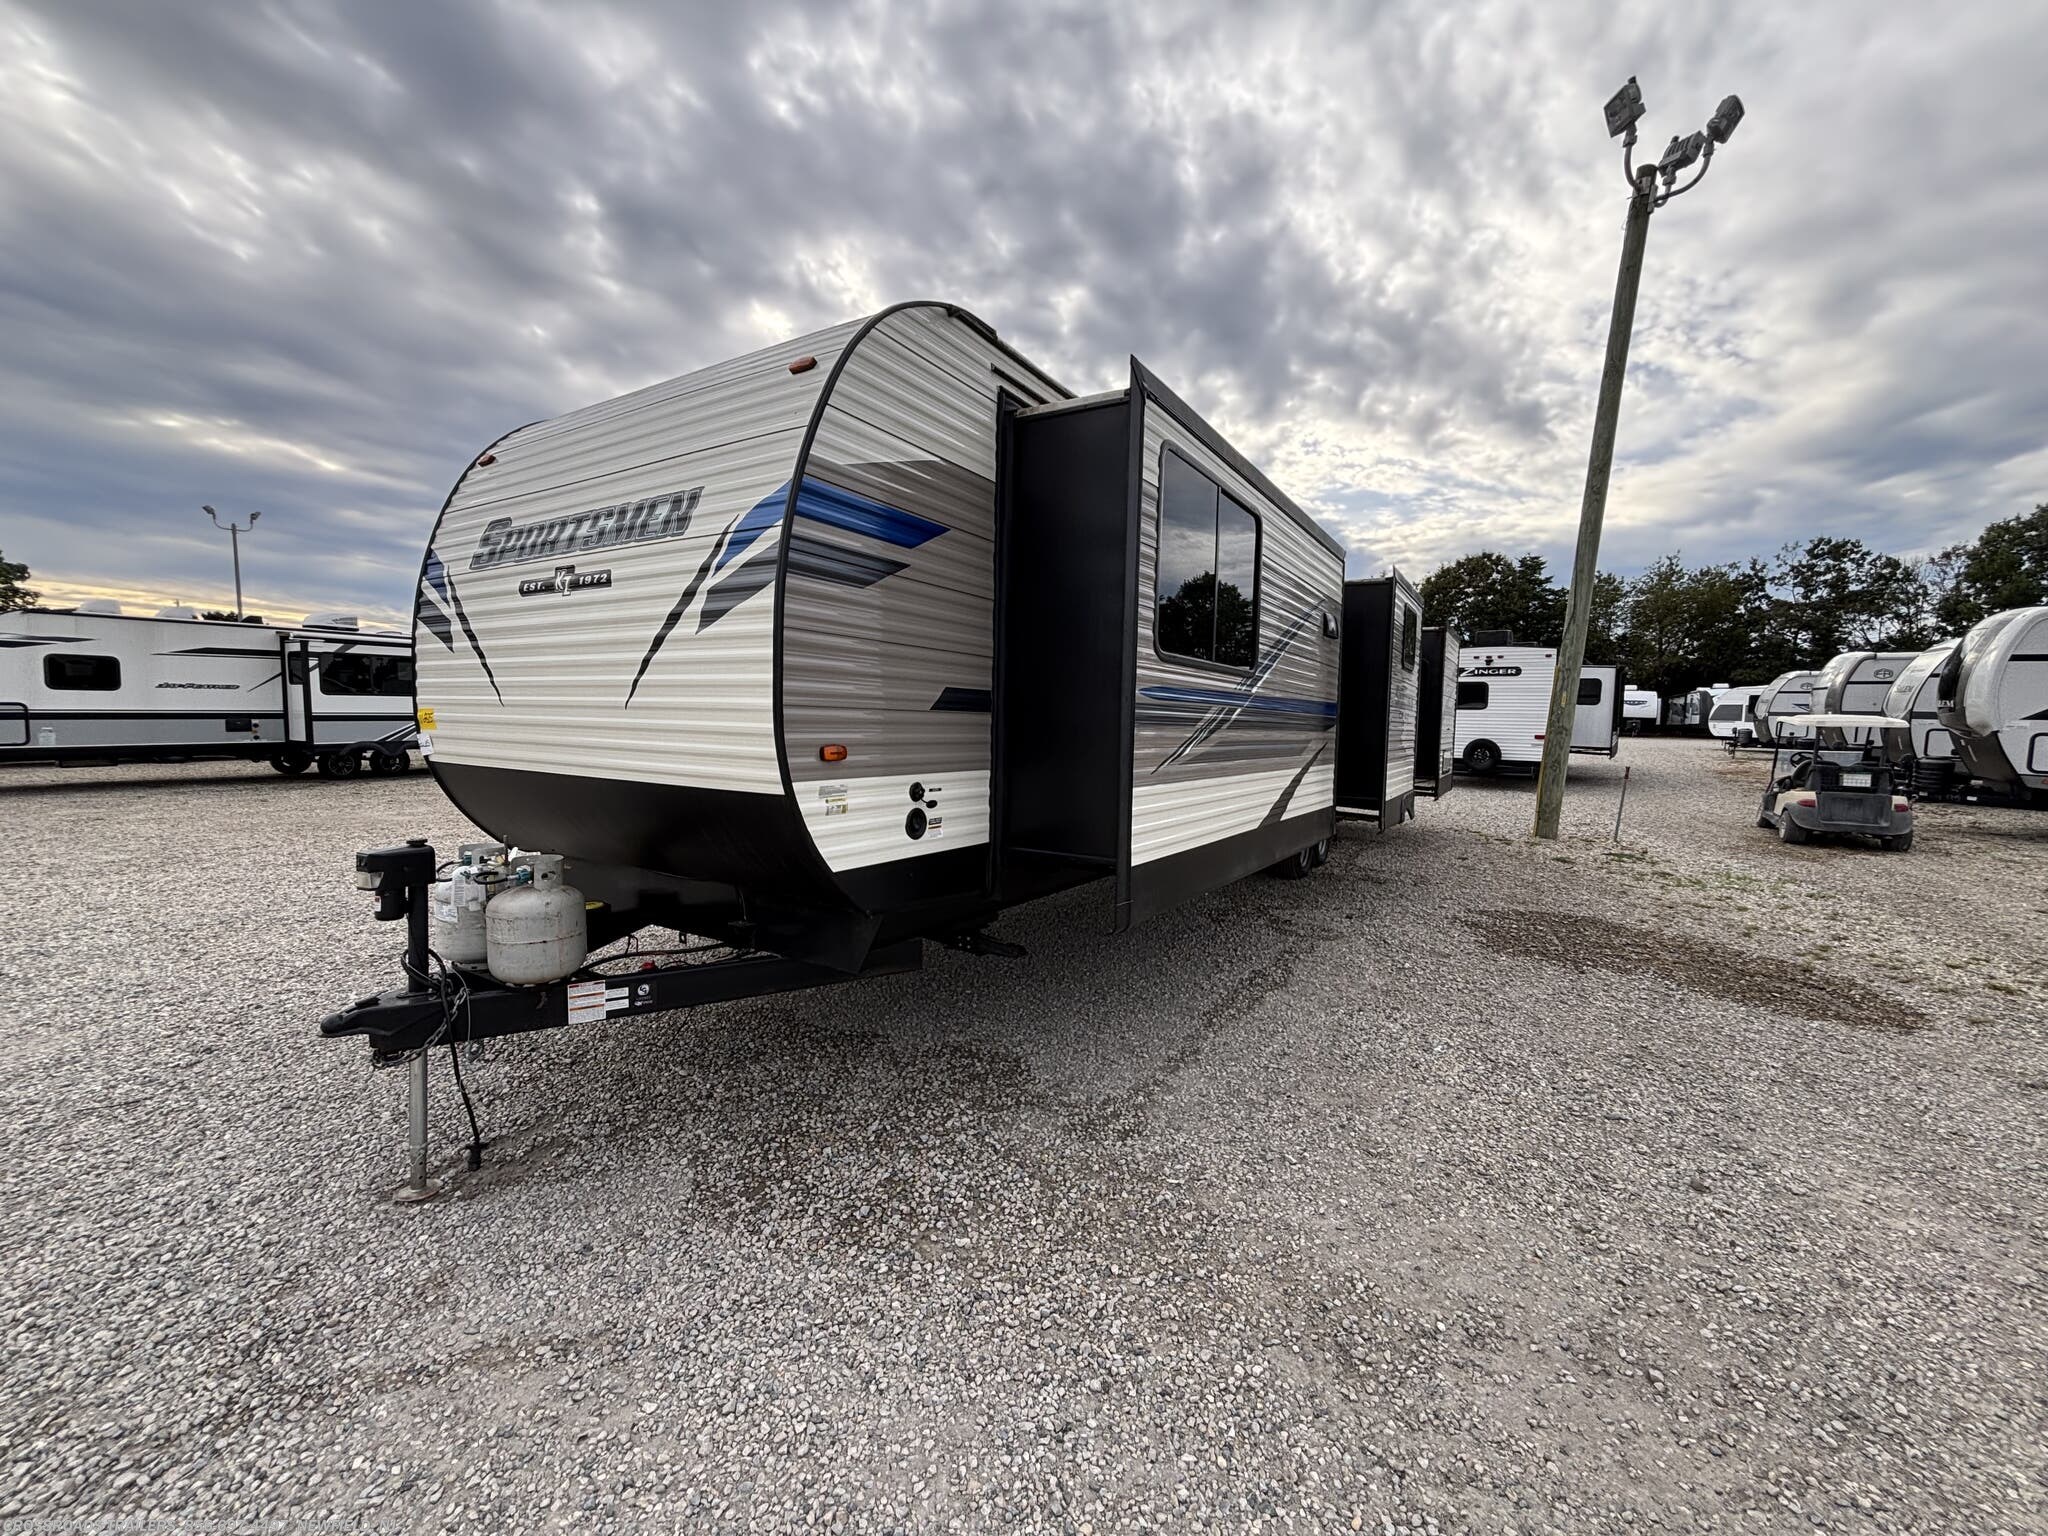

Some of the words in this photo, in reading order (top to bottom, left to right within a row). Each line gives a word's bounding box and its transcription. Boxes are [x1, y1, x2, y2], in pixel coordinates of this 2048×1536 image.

[523, 581, 546, 592] EST.
[578, 573, 608, 585] 1972
[1459, 667, 1517, 677] ZINGER
